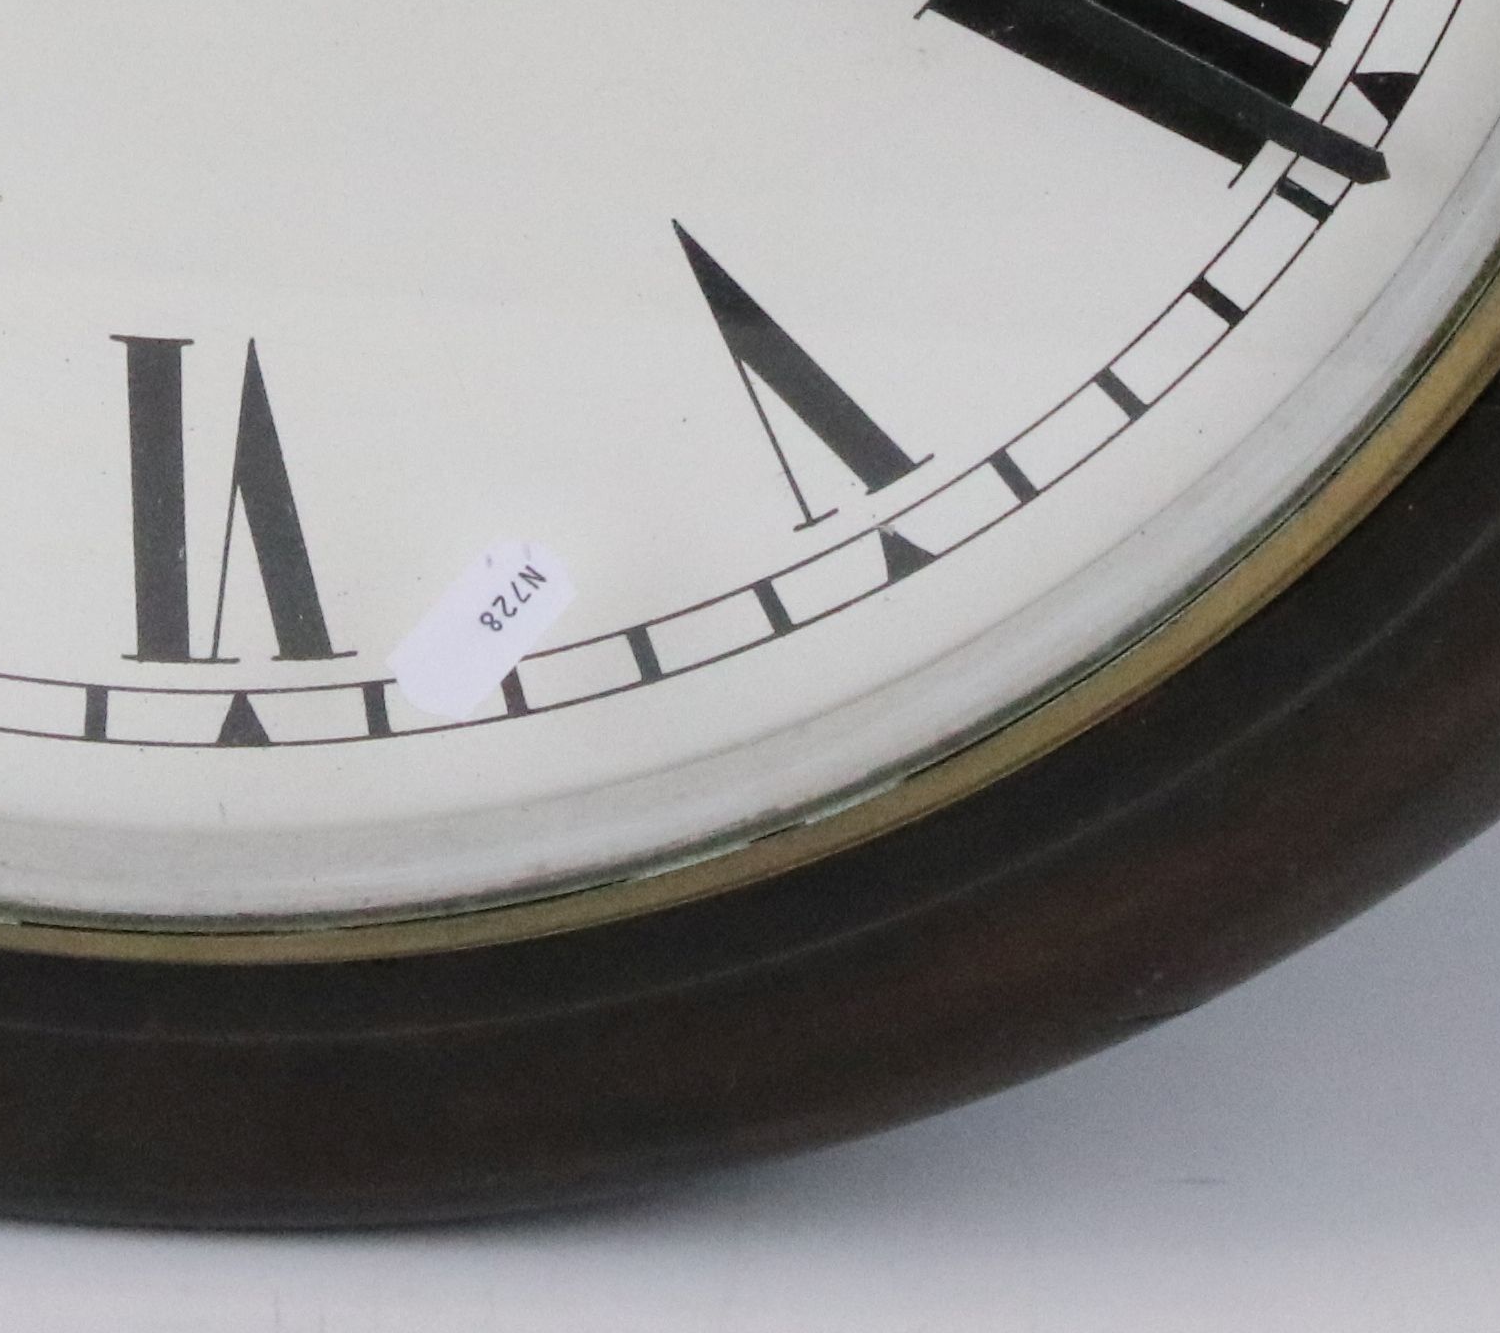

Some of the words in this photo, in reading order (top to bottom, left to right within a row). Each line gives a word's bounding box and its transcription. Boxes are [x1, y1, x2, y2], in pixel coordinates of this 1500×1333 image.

[108, 333, 358, 665] VI
[671, 218, 934, 532] V
[479, 564, 547, 632] N728
